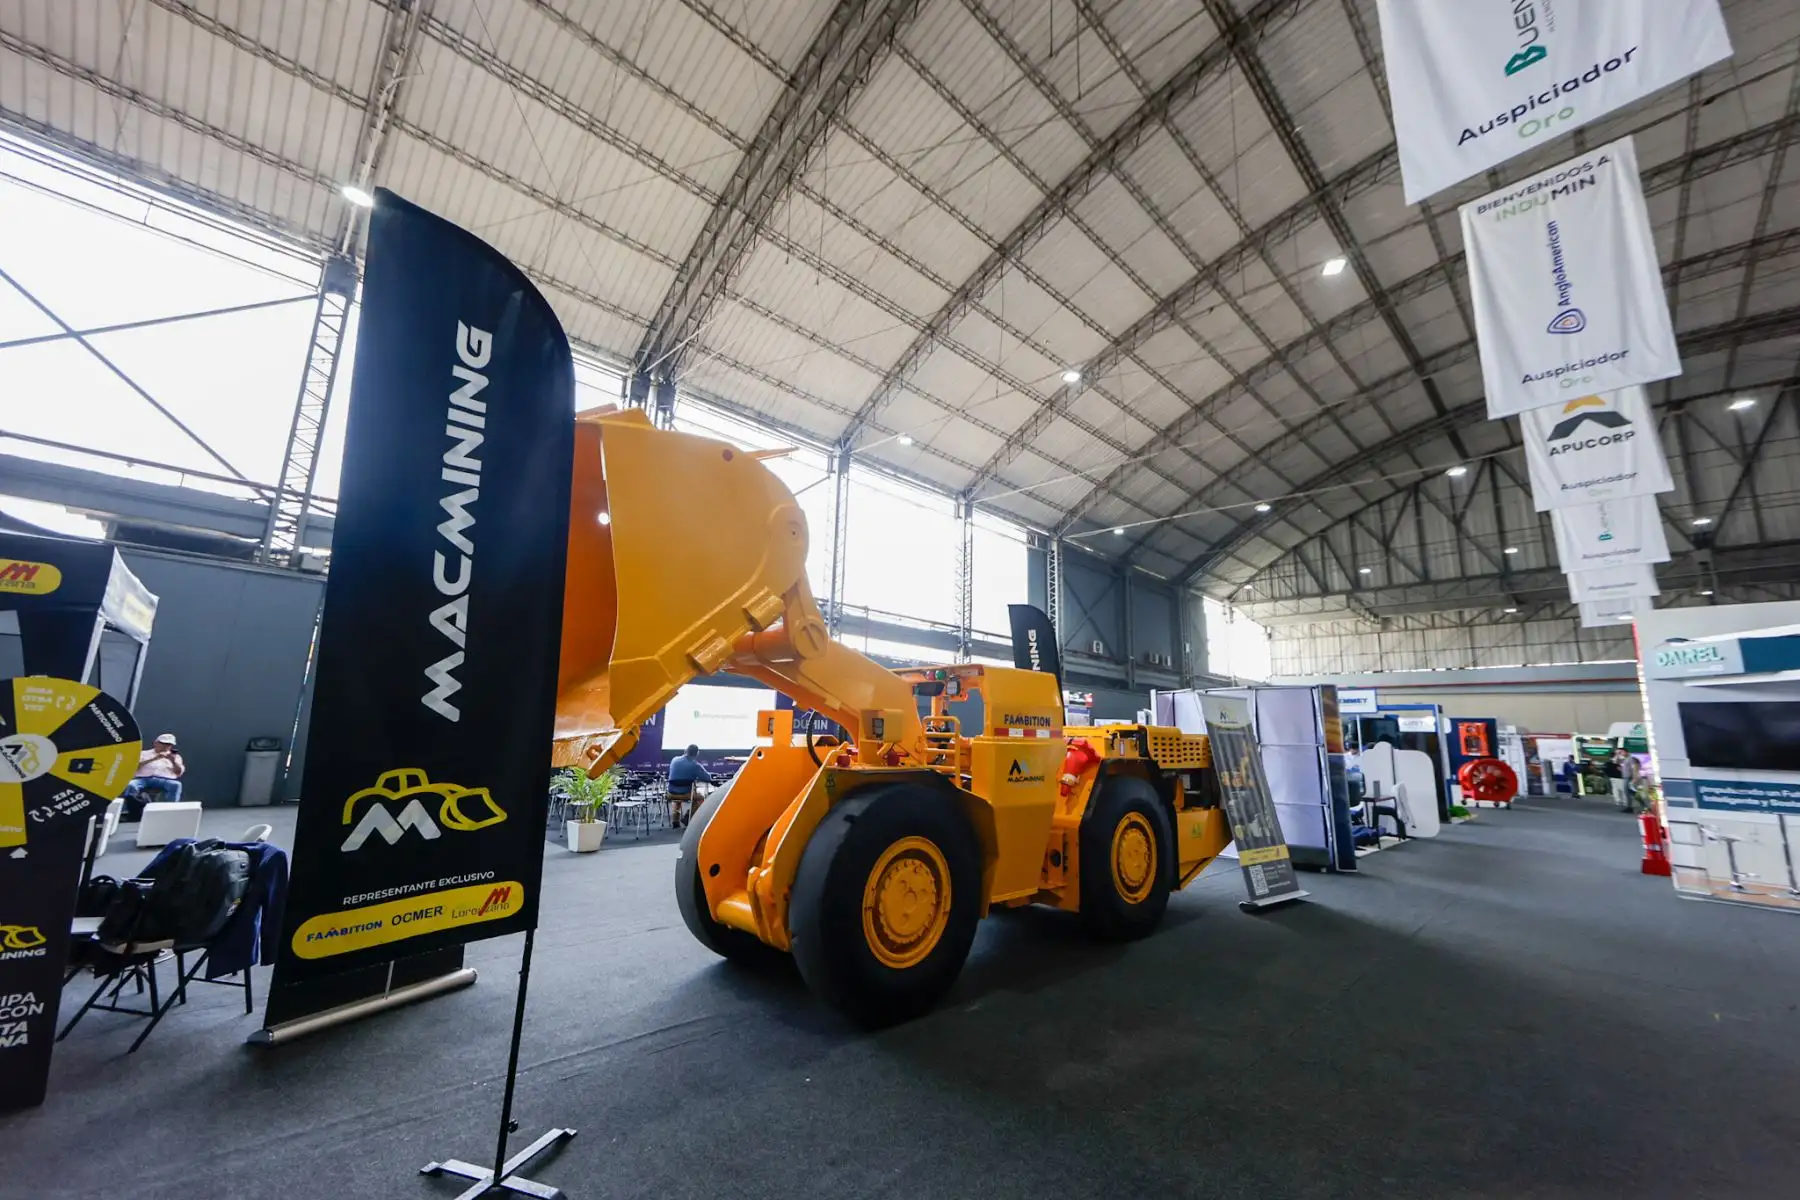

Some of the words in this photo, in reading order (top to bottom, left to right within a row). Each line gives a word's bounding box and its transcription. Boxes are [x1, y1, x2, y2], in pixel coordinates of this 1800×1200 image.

[1457, 46, 1639, 146] Auspiciador
[1518, 106, 1576, 139] Oro
[1477, 161, 1593, 215] BIENVENIDOS
[1598, 155, 1611, 167] A
[1495, 174, 1597, 222] INDUMIN
[1547, 220, 1573, 307] AngloAmerican
[1521, 350, 1630, 384] Auspiciador
[1560, 376, 1593, 389] Oro
[1549, 431, 1636, 457] APUCORP
[1560, 471, 1639, 492] Auspiciador
[421, 319, 494, 722] MACMINING
[89, 703, 123, 743] PARTICIPANDO
[1004, 712, 1051, 728] FAMBITION
[52, 789, 75, 801] VEZ
[54, 793, 85, 810] OTRA
[62, 799, 90, 816] GIRA
[342, 880, 436, 905] REPRESENTANTE
[438, 871, 495, 888] EXCLUSIVO
[306, 919, 383, 942] FAMBITION
[391, 905, 444, 927] OCMER
[0, 1002, 44, 1020] CON
